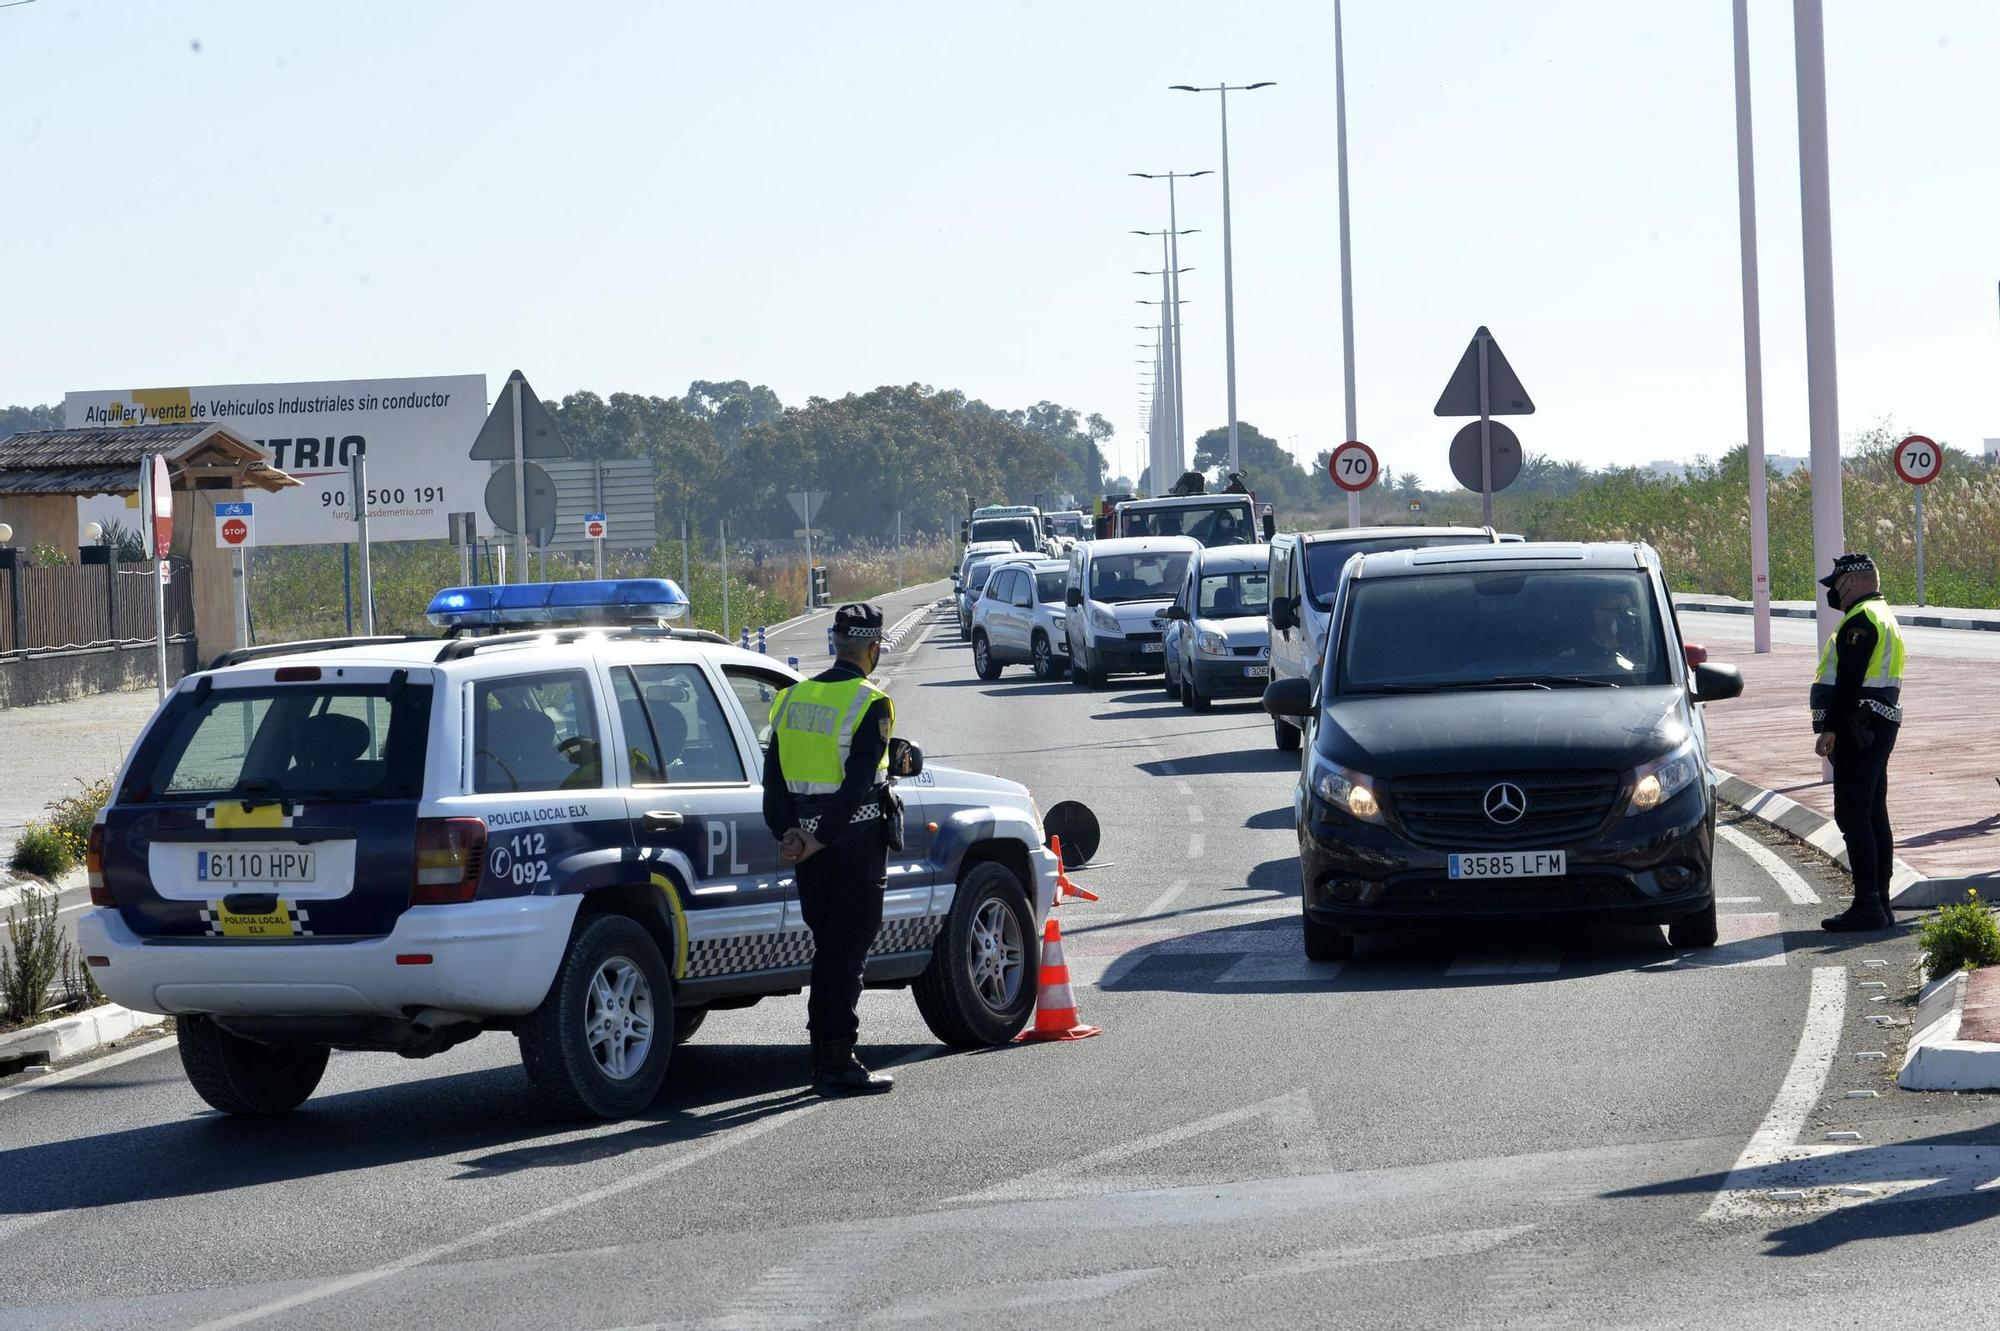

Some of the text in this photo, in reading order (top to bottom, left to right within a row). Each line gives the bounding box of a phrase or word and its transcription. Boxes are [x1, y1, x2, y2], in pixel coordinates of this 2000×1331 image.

[85, 392, 450, 425] Alquiler y venta de Vehículos Industriales sin conductor
[253, 435, 366, 468] TRIO
[1907, 452, 1931, 468] 70
[1342, 458, 1367, 475] 70
[321, 486, 444, 507] 90 500 191
[224, 528, 245, 536] STOP
[488, 804, 589, 826] POLICIA LOCAL ELX
[511, 832, 546, 857] 112
[707, 820, 749, 876] PL
[211, 854, 262, 878] 6110
[270, 854, 309, 878] HPV
[512, 861, 551, 885] 092
[1463, 854, 1561, 876] 3585 LFM
[224, 917, 286, 925] POLICIA LOCAL
[249, 926, 266, 934] ELX
